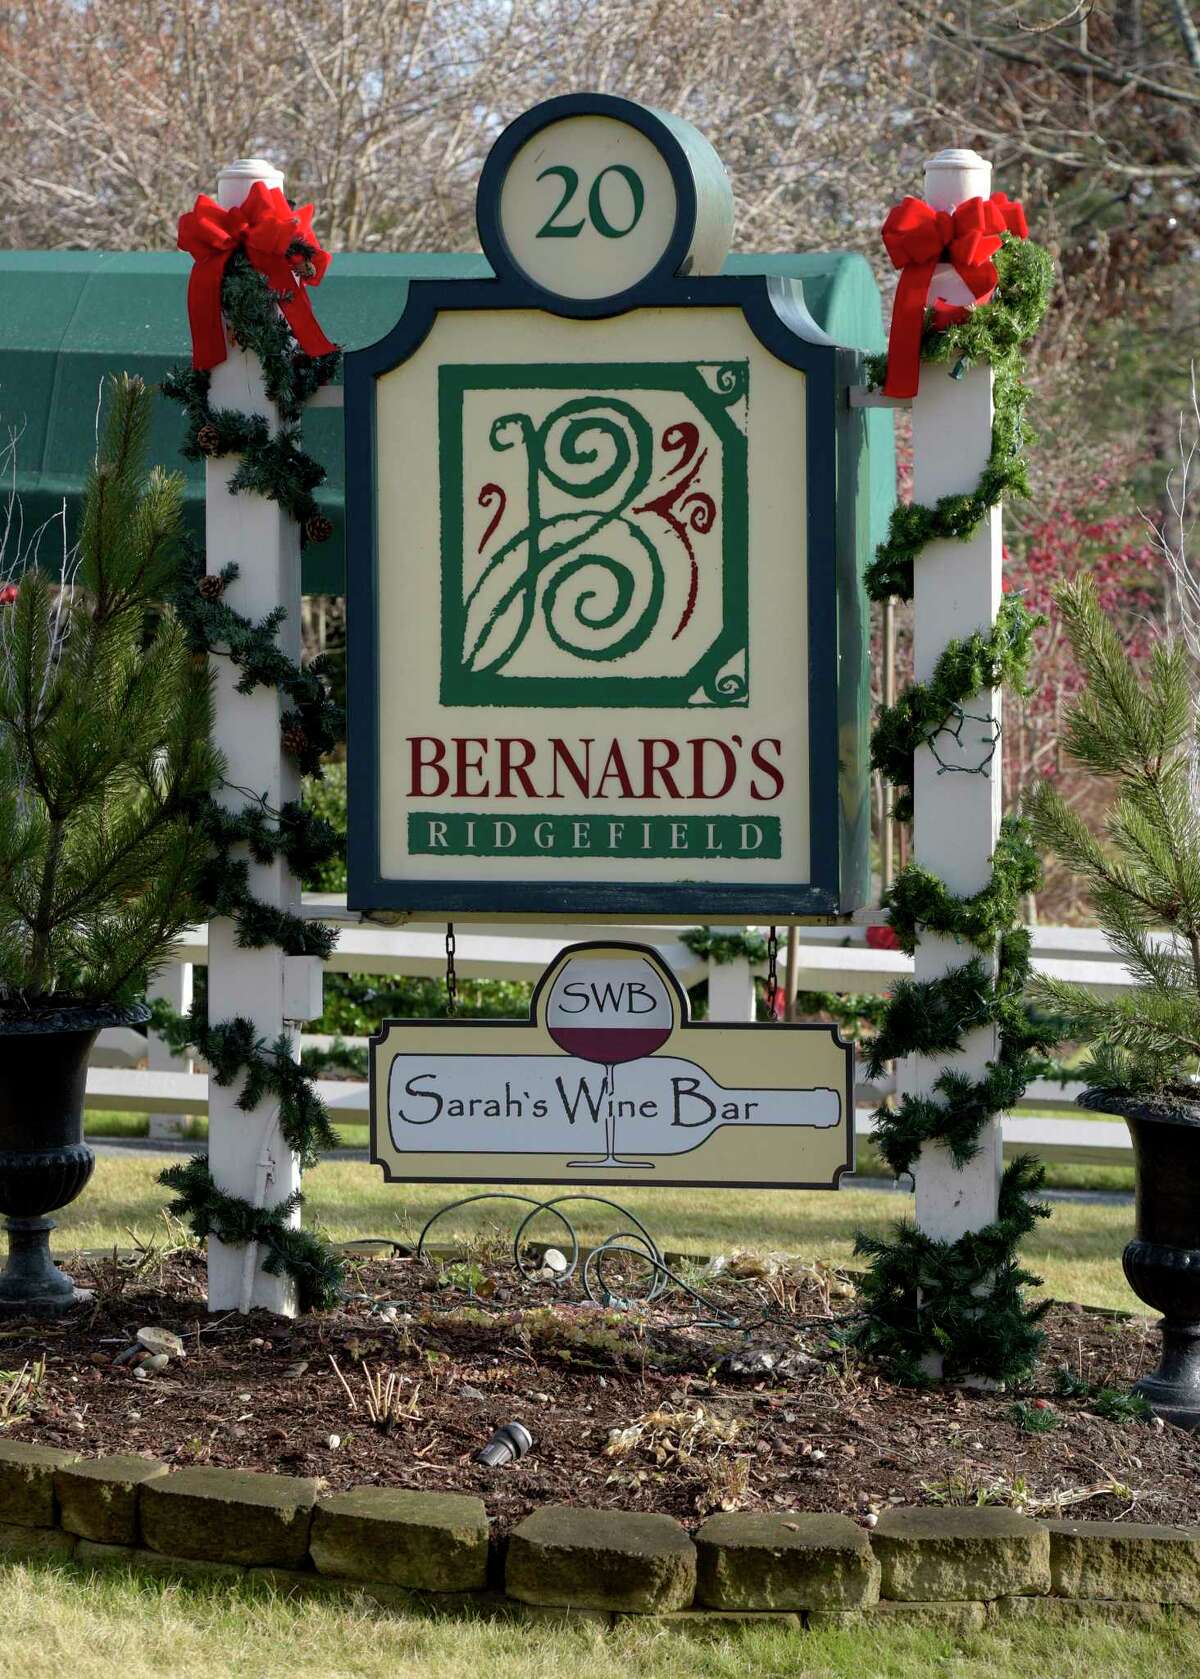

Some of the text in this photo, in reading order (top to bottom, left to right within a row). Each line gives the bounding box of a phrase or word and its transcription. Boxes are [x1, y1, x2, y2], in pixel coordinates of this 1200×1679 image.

[535, 164, 645, 239] 20
[405, 734, 785, 800] BERNARD'S
[426, 820, 764, 851] RIDGEFIELD
[557, 982, 658, 1014] SWB
[398, 1073, 759, 1128] Sarah's Wine Bar
